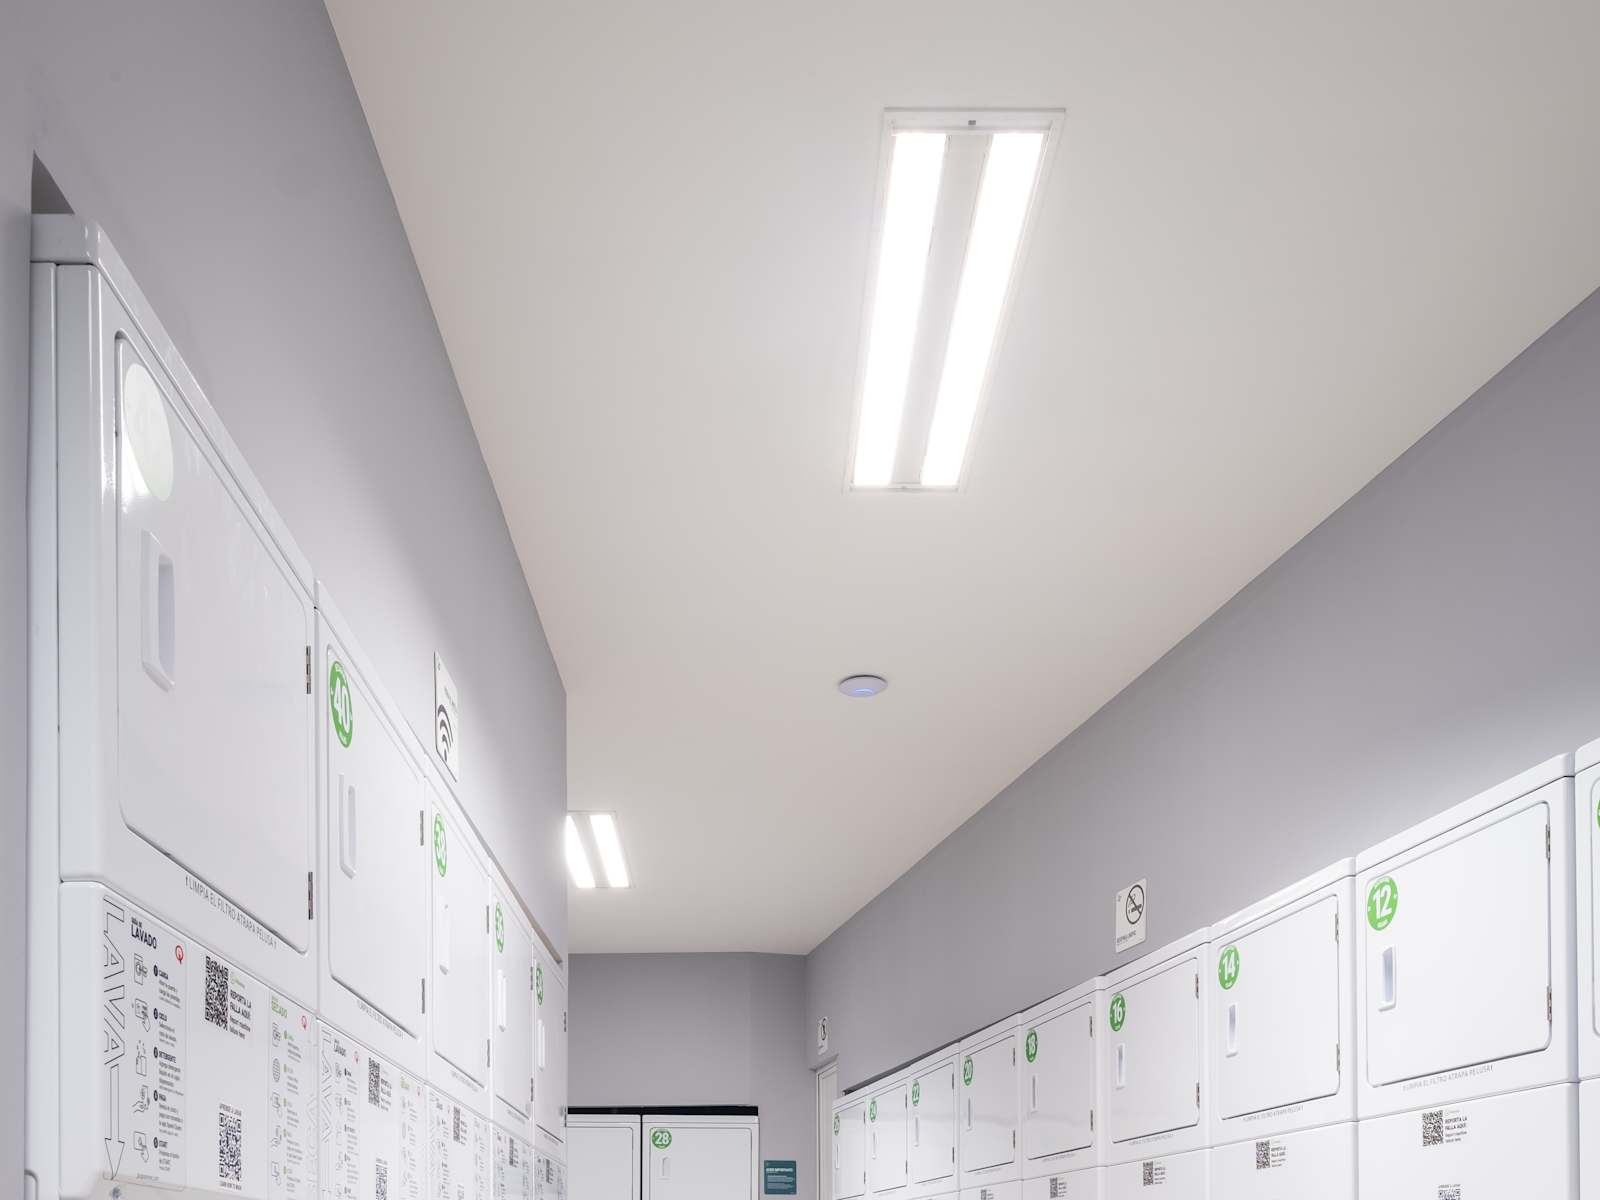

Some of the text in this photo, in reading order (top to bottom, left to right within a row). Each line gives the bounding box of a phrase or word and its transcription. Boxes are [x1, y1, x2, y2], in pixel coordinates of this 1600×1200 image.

[334, 677, 350, 735] 40
[1373, 884, 1392, 920] 12
[131, 923, 157, 949] LAVADO
[1222, 951, 1236, 981] 14
[1113, 999, 1123, 1023] 16
[655, 1132, 670, 1145] 28
